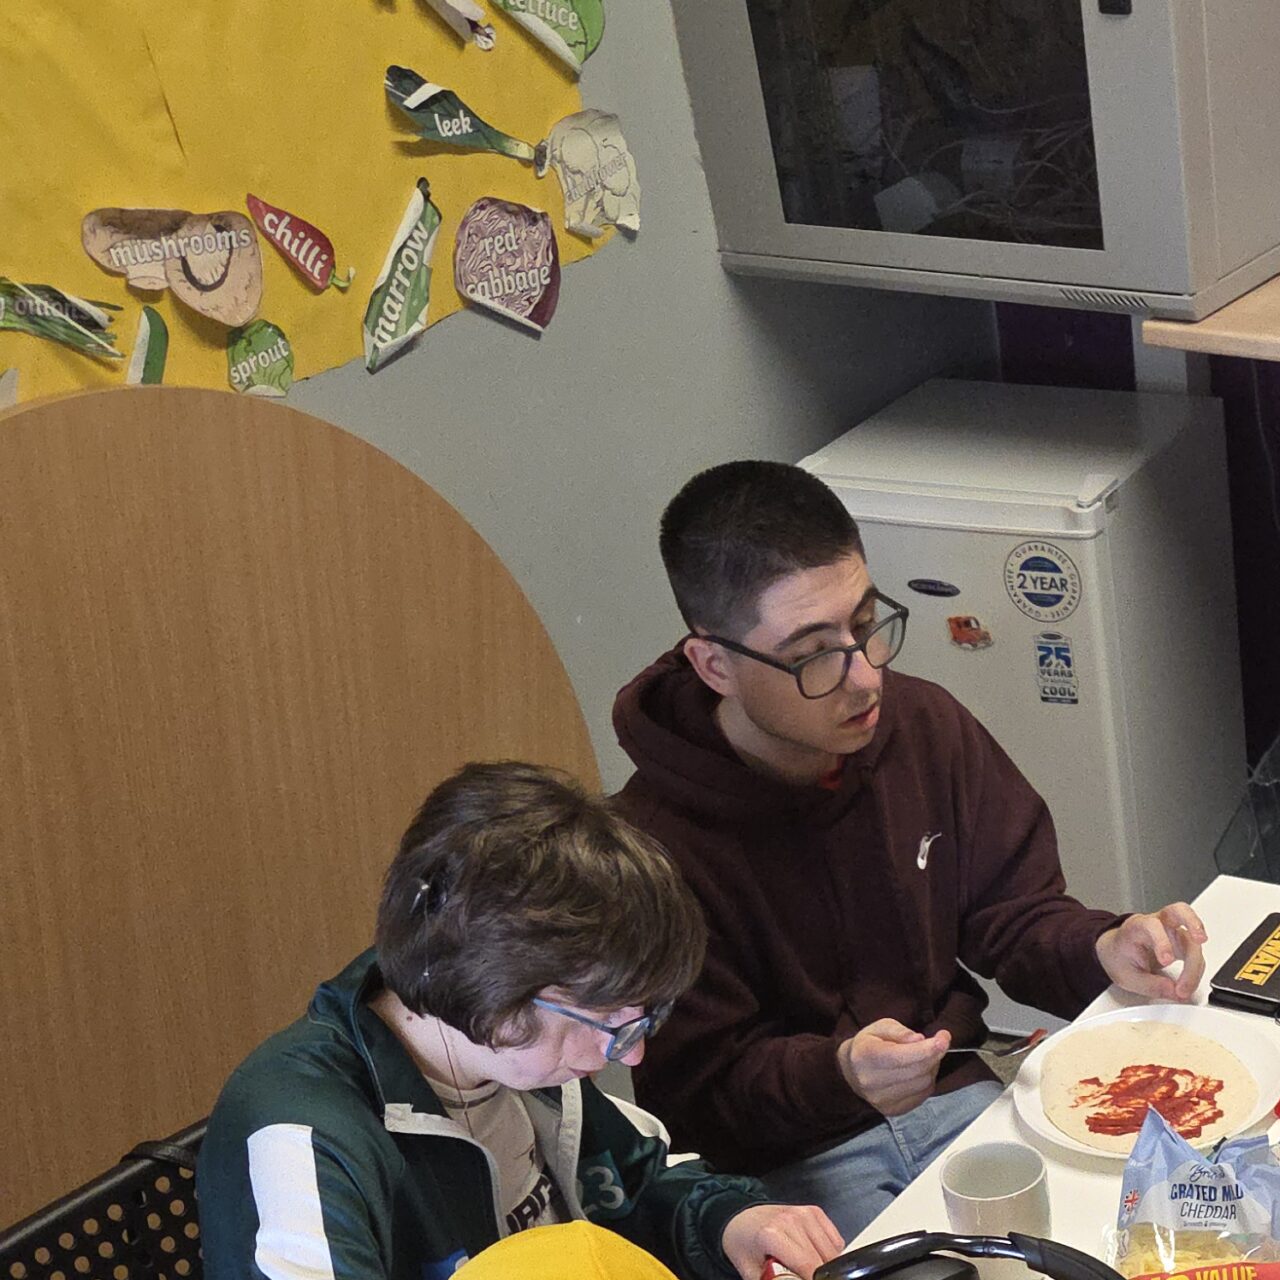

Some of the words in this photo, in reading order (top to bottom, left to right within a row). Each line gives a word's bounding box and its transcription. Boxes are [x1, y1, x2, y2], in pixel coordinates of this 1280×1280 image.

[507, 0, 579, 30] ettuce
[434, 110, 473, 137] leek
[109, 226, 251, 267] mushrooms
[263, 212, 330, 280] chilli
[483, 223, 519, 256] red
[373, 221, 430, 348] marrow
[466, 265, 551, 301] cabbage
[230, 337, 290, 385] sprout
[1017, 572, 1028, 589] 2
[1030, 575, 1069, 592] YEAR
[1170, 1184, 1217, 1202] GRATED
[1180, 1201, 1237, 1220] CHEDDAR
